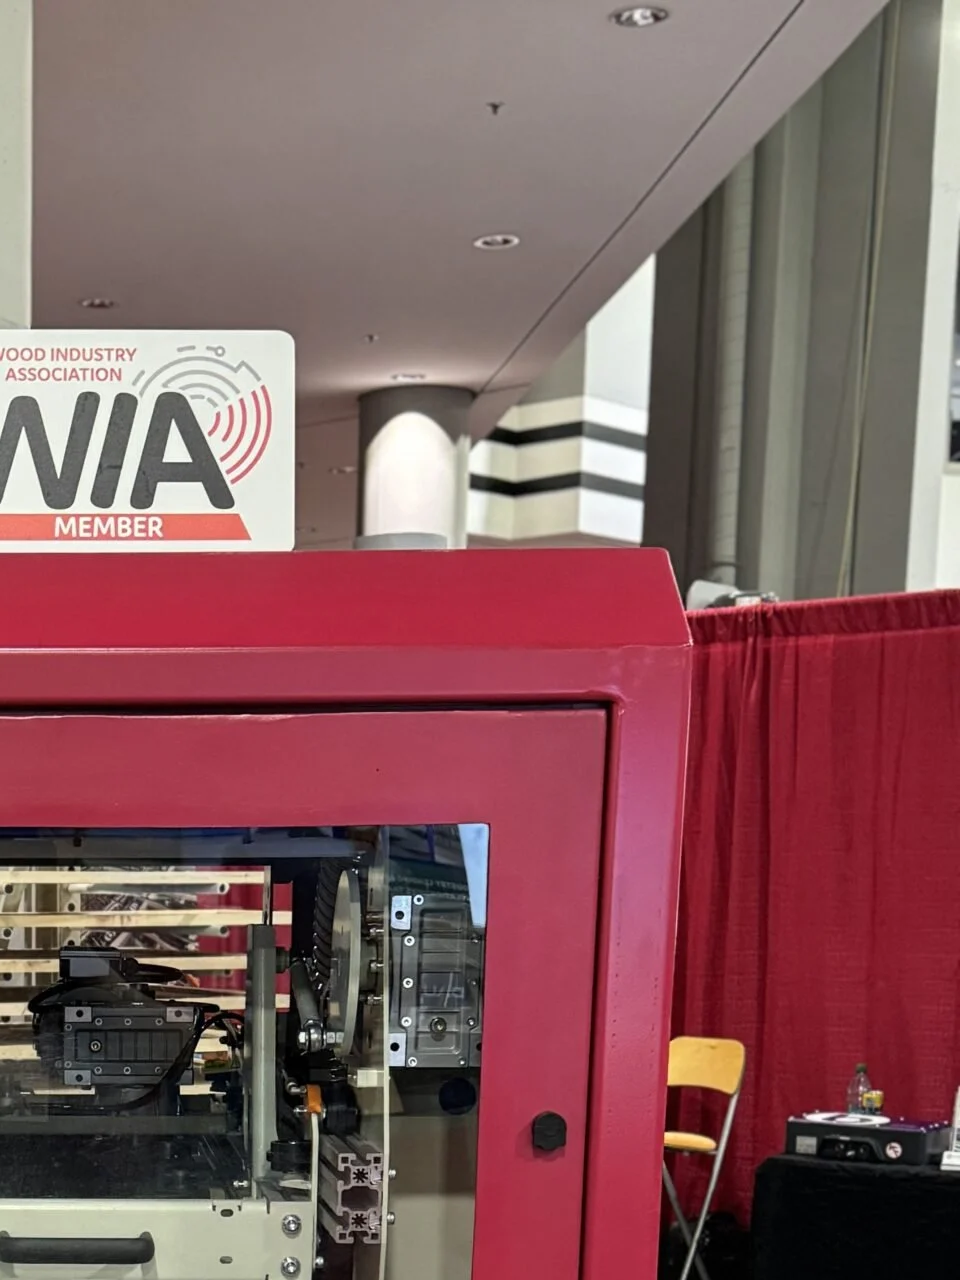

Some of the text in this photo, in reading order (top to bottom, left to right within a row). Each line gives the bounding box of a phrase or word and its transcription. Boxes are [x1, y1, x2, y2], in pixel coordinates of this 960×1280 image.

[50, 346, 137, 363] INDUSTRY
[4, 366, 123, 382] ASSOCIATION
[53, 515, 164, 538] MEMBER
